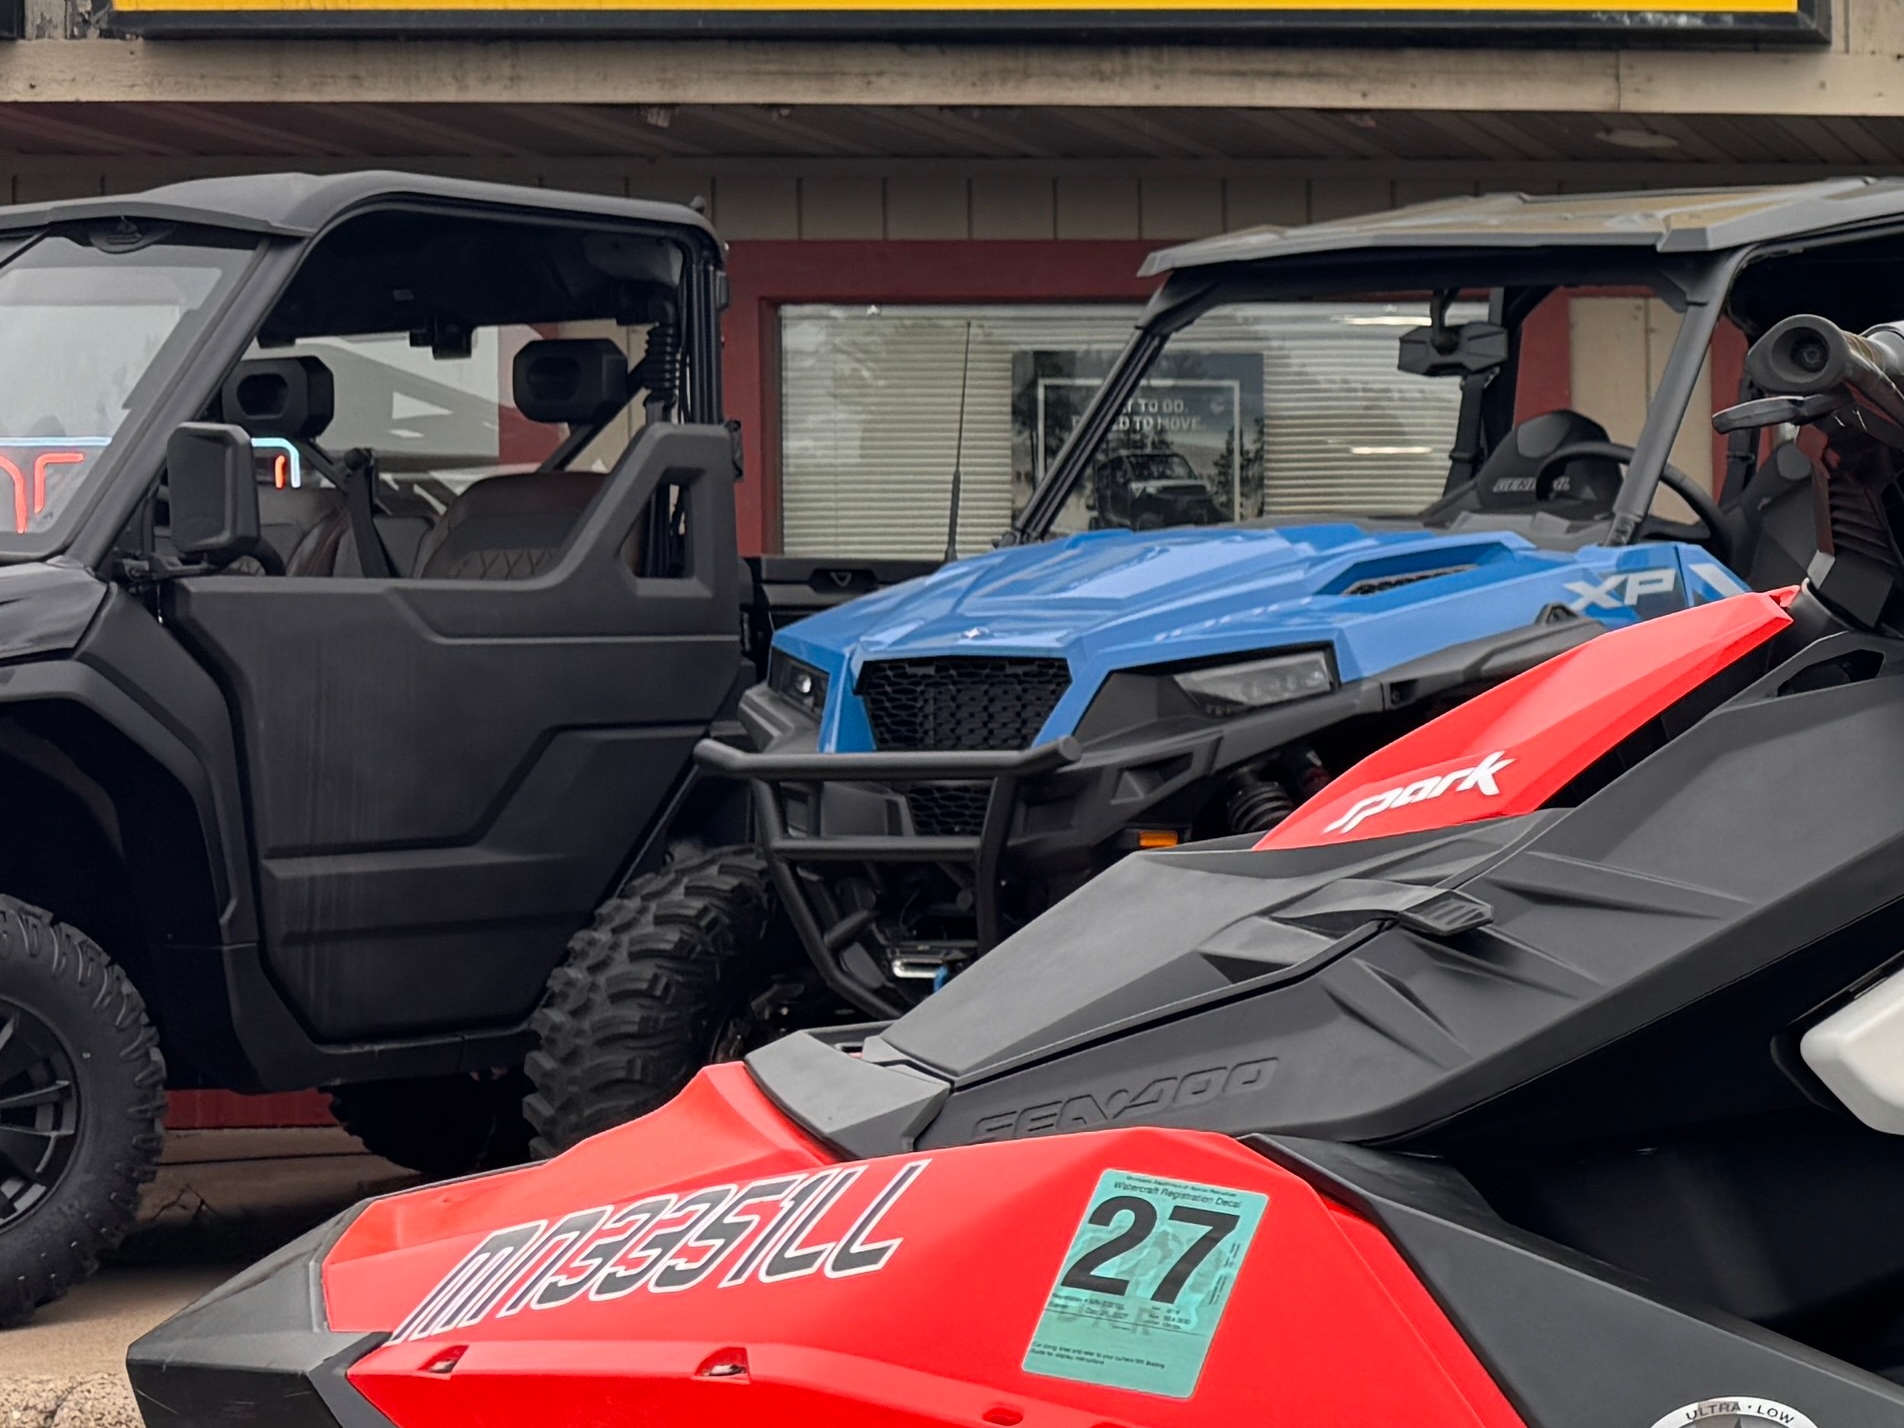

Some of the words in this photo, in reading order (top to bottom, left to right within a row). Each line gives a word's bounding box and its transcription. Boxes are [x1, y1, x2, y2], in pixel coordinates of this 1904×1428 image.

[1562, 568, 1676, 611] XP
[1321, 750, 1516, 834] spark
[1112, 1180, 1160, 1195] Watercraft
[1158, 1187, 1215, 1206] Registration
[1213, 1196, 1243, 1209] Decal
[1060, 1195, 1241, 1304] 27
[1685, 1400, 1742, 1421] ULTRA
[1756, 1404, 1796, 1424] LOW
